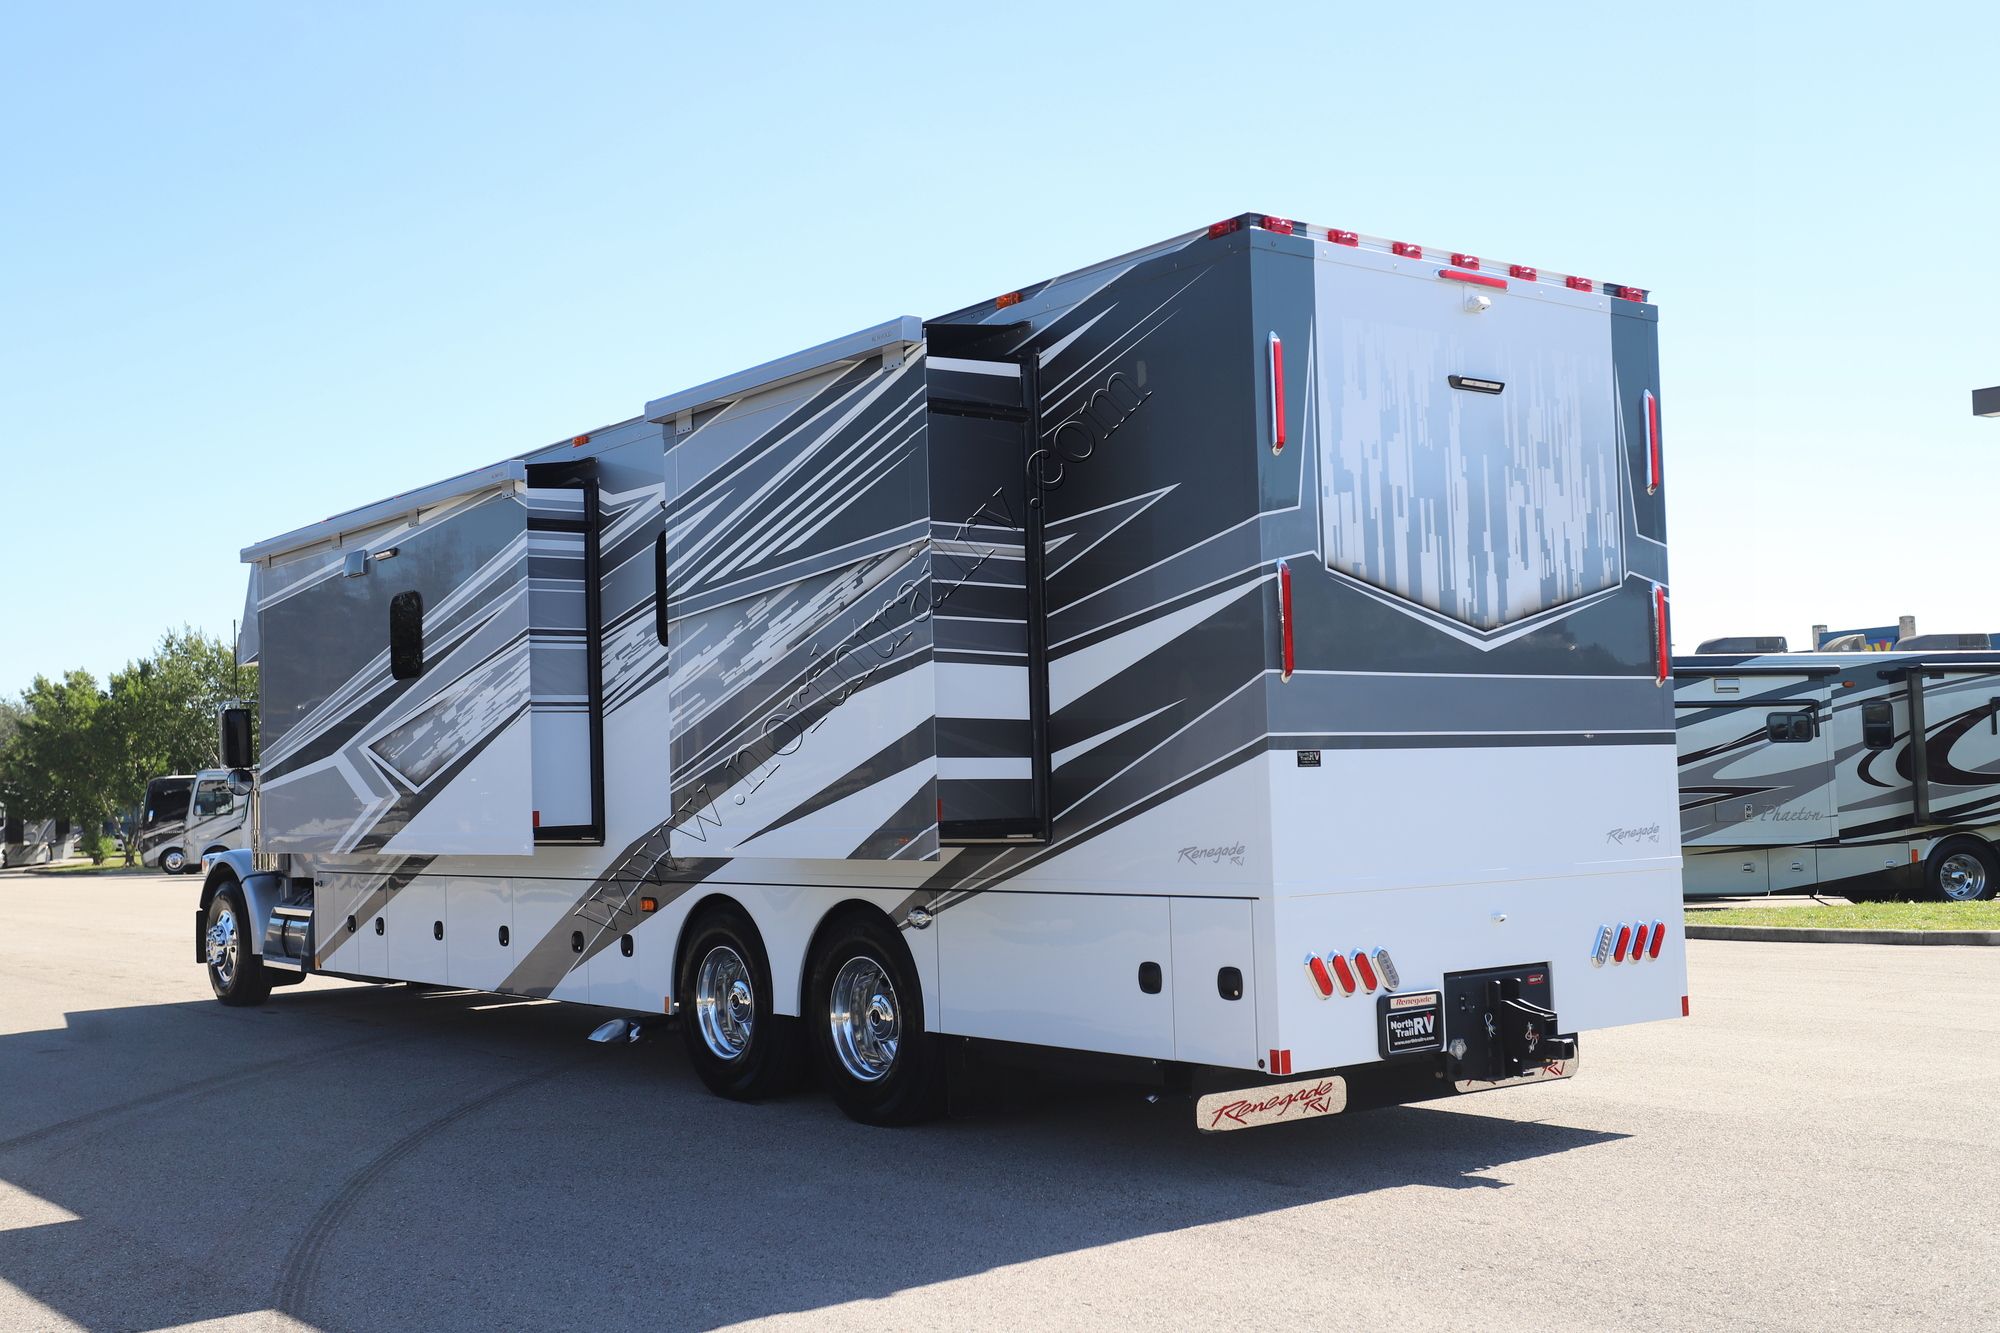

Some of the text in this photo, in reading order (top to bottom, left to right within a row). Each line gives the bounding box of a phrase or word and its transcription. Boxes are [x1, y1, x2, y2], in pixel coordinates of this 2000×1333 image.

[1758, 801, 1828, 822] Phaeton
[1606, 822, 1660, 845] Renegade
[1177, 841, 1246, 865] Renegade
[1229, 856, 1245, 866] RV
[1396, 996, 1432, 1006] Renegade
[1390, 1019, 1414, 1030] North
[1395, 1028, 1414, 1038] Trail
[1413, 1015, 1435, 1036] RV
[1211, 1080, 1333, 1127] Renegade
[1302, 1096, 1331, 1113] RV
